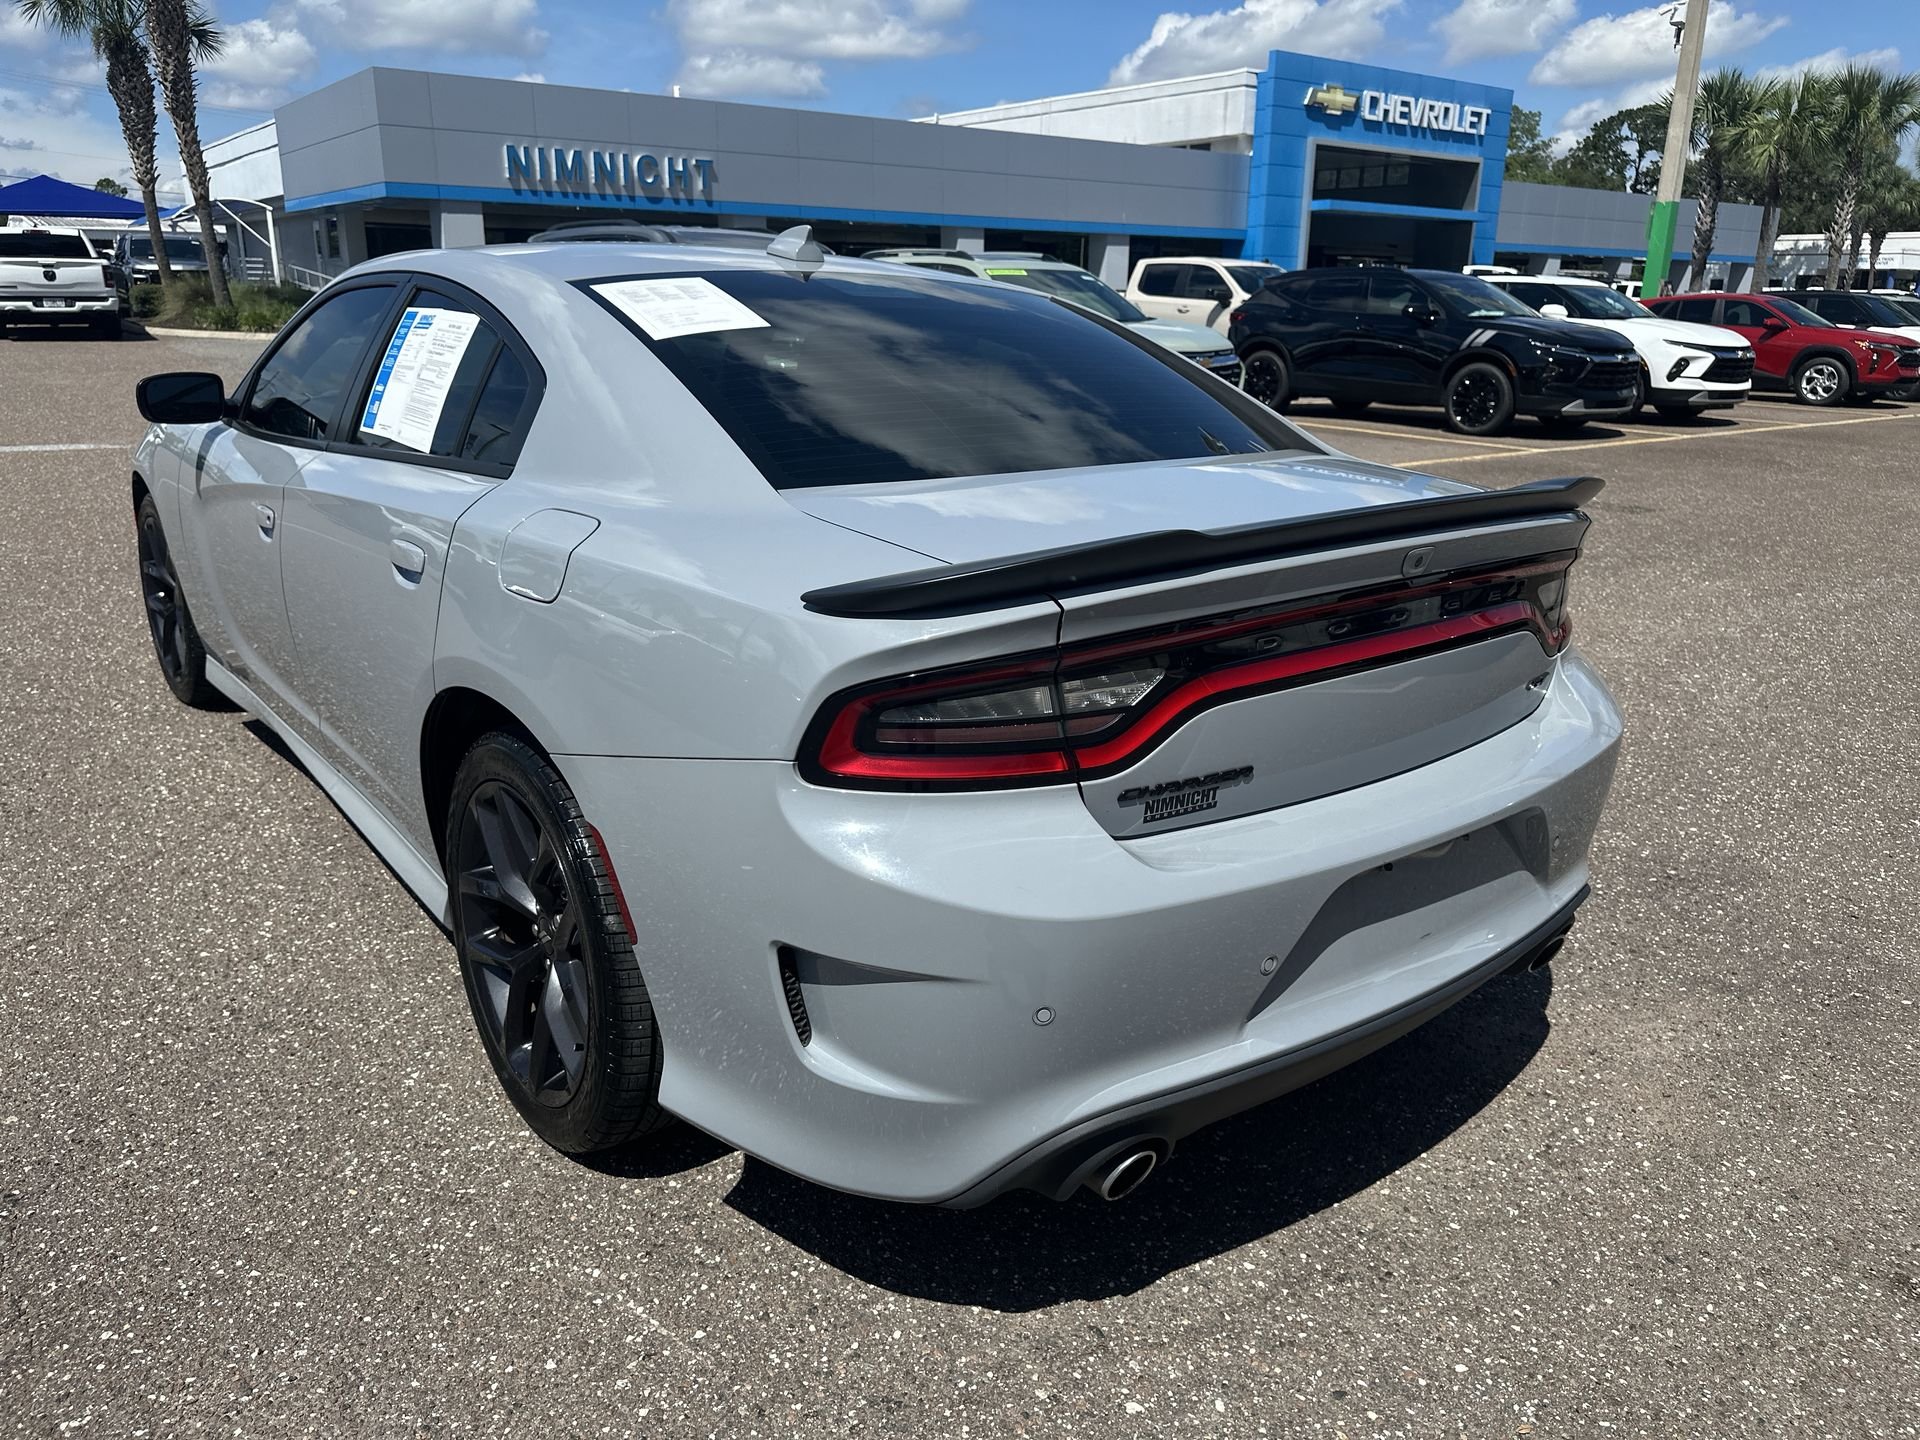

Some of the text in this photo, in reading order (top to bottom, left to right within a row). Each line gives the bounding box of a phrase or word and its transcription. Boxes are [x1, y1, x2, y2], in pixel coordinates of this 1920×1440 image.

[1362, 89, 1491, 135] CHEVROLET
[504, 144, 714, 190] NIMNICHT
[1117, 764, 1254, 802] CHARGER
[1143, 786, 1220, 816] NIMNICHT
